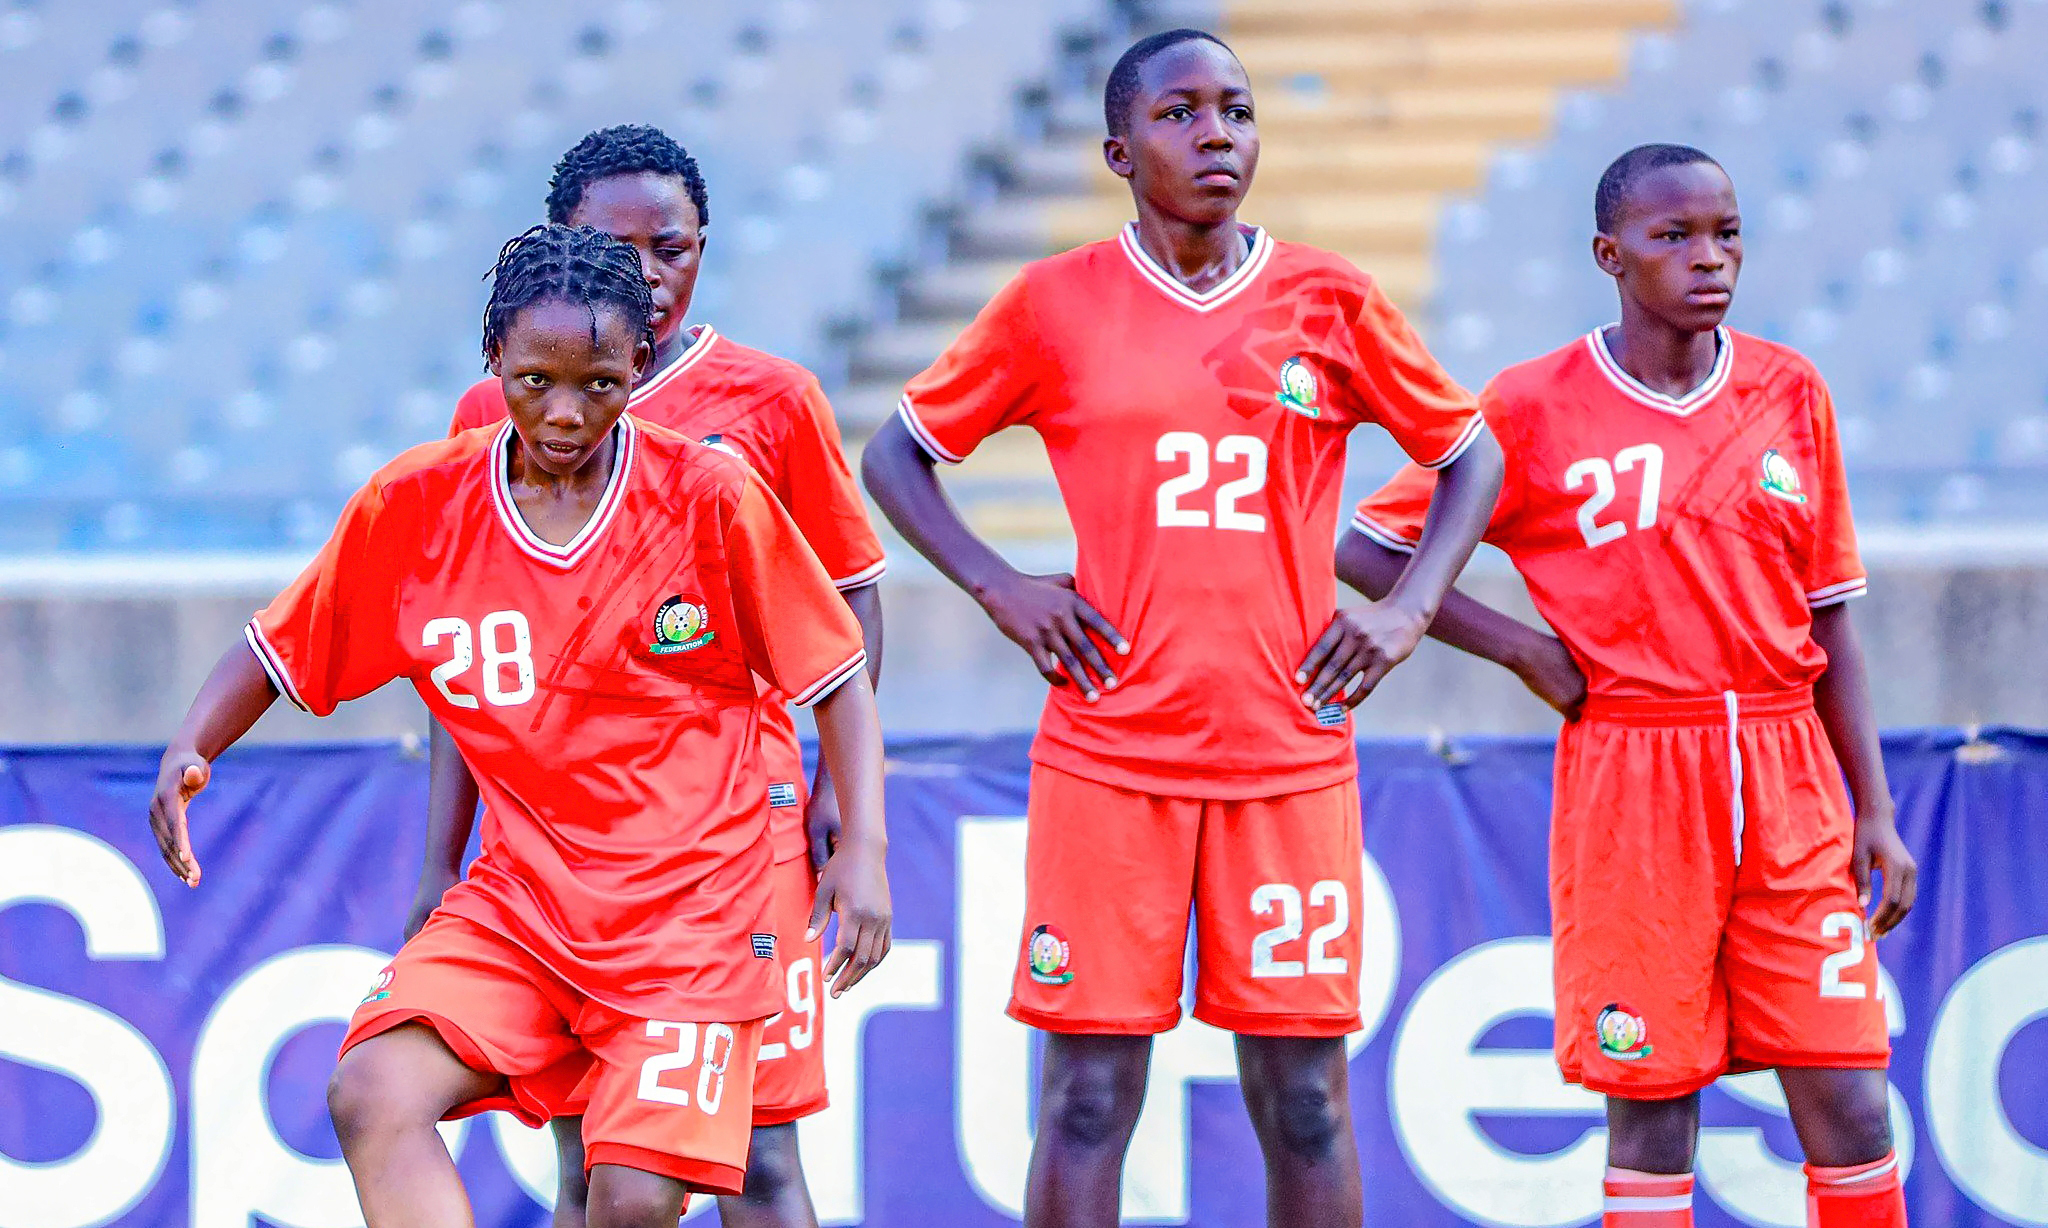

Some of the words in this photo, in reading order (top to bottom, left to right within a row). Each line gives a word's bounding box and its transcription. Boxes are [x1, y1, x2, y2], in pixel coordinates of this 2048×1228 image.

[1156, 431, 1268, 532] 22
[1564, 443, 1664, 549] 27
[422, 609, 536, 710] 28
[656, 604, 670, 642] FOOTBALL
[660, 639, 703, 653] FEDERATION
[1250, 879, 1349, 978] 22
[637, 1019, 734, 1115] 28
